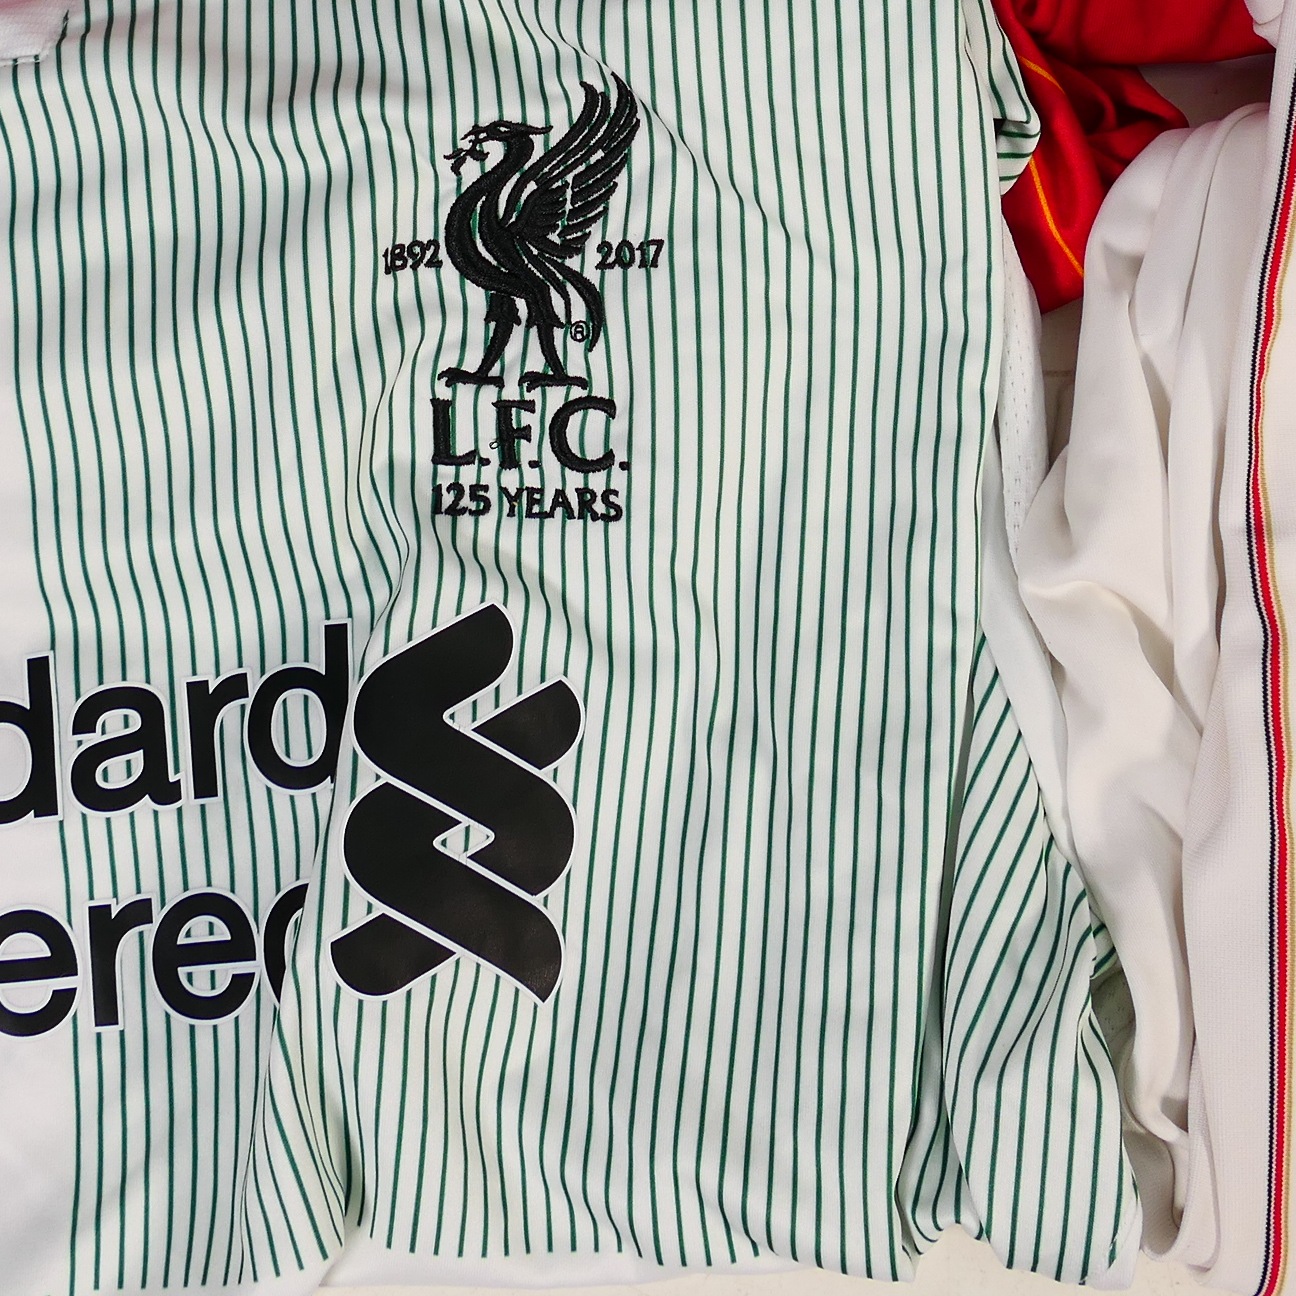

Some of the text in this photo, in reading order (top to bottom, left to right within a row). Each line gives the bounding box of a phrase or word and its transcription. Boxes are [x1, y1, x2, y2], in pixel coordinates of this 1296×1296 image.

[383, 239, 443, 275] 1892
[596, 239, 664, 270] 2017
[430, 395, 630, 473] L.F.C.
[432, 483, 624, 522] 125 YEARS
